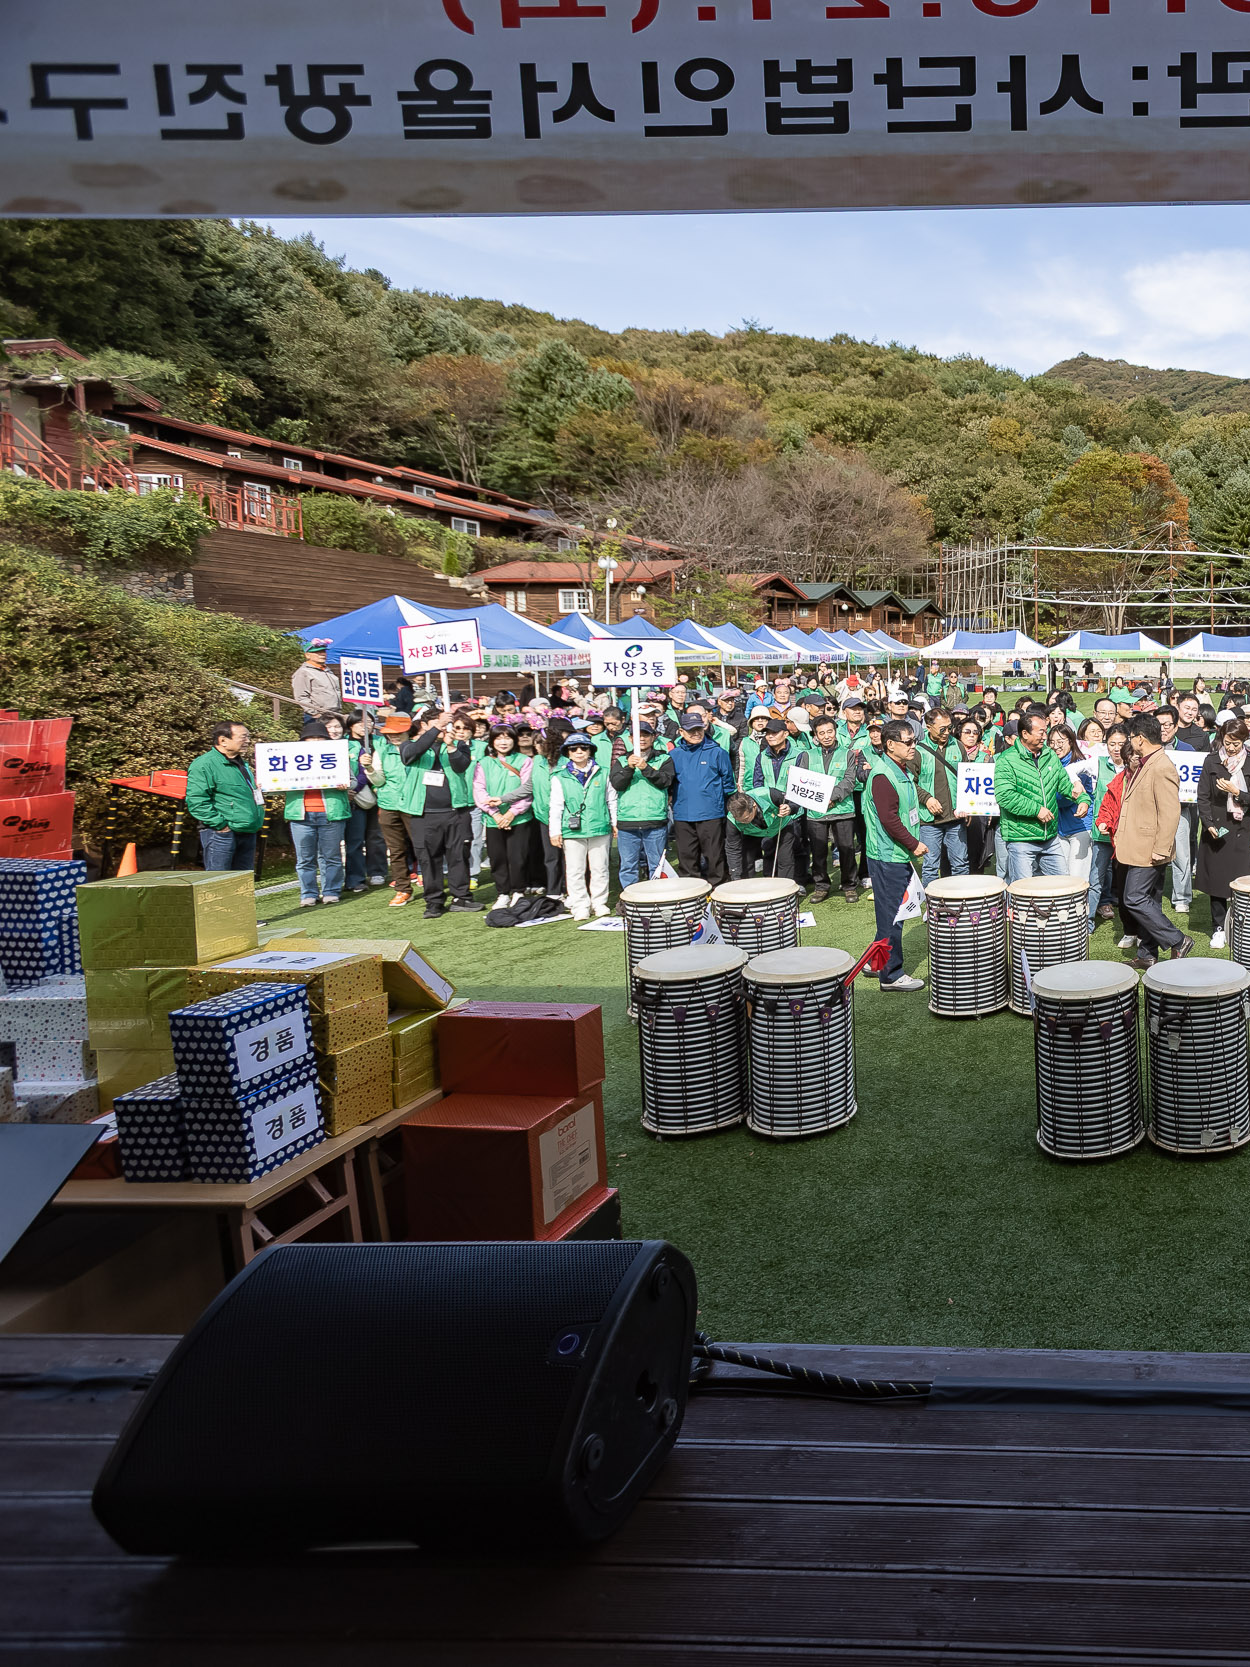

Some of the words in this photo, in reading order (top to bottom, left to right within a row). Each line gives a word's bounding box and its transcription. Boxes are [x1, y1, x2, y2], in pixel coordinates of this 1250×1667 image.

[603, 661, 666, 678] 자양3동
[343, 668, 379, 699] 화양동
[268, 753, 338, 772] 화양동
[1176, 764, 1202, 784] 3동
[791, 783, 825, 803] 자양2동
[248, 1026, 295, 1063] 경품
[264, 1102, 307, 1141] 경품
